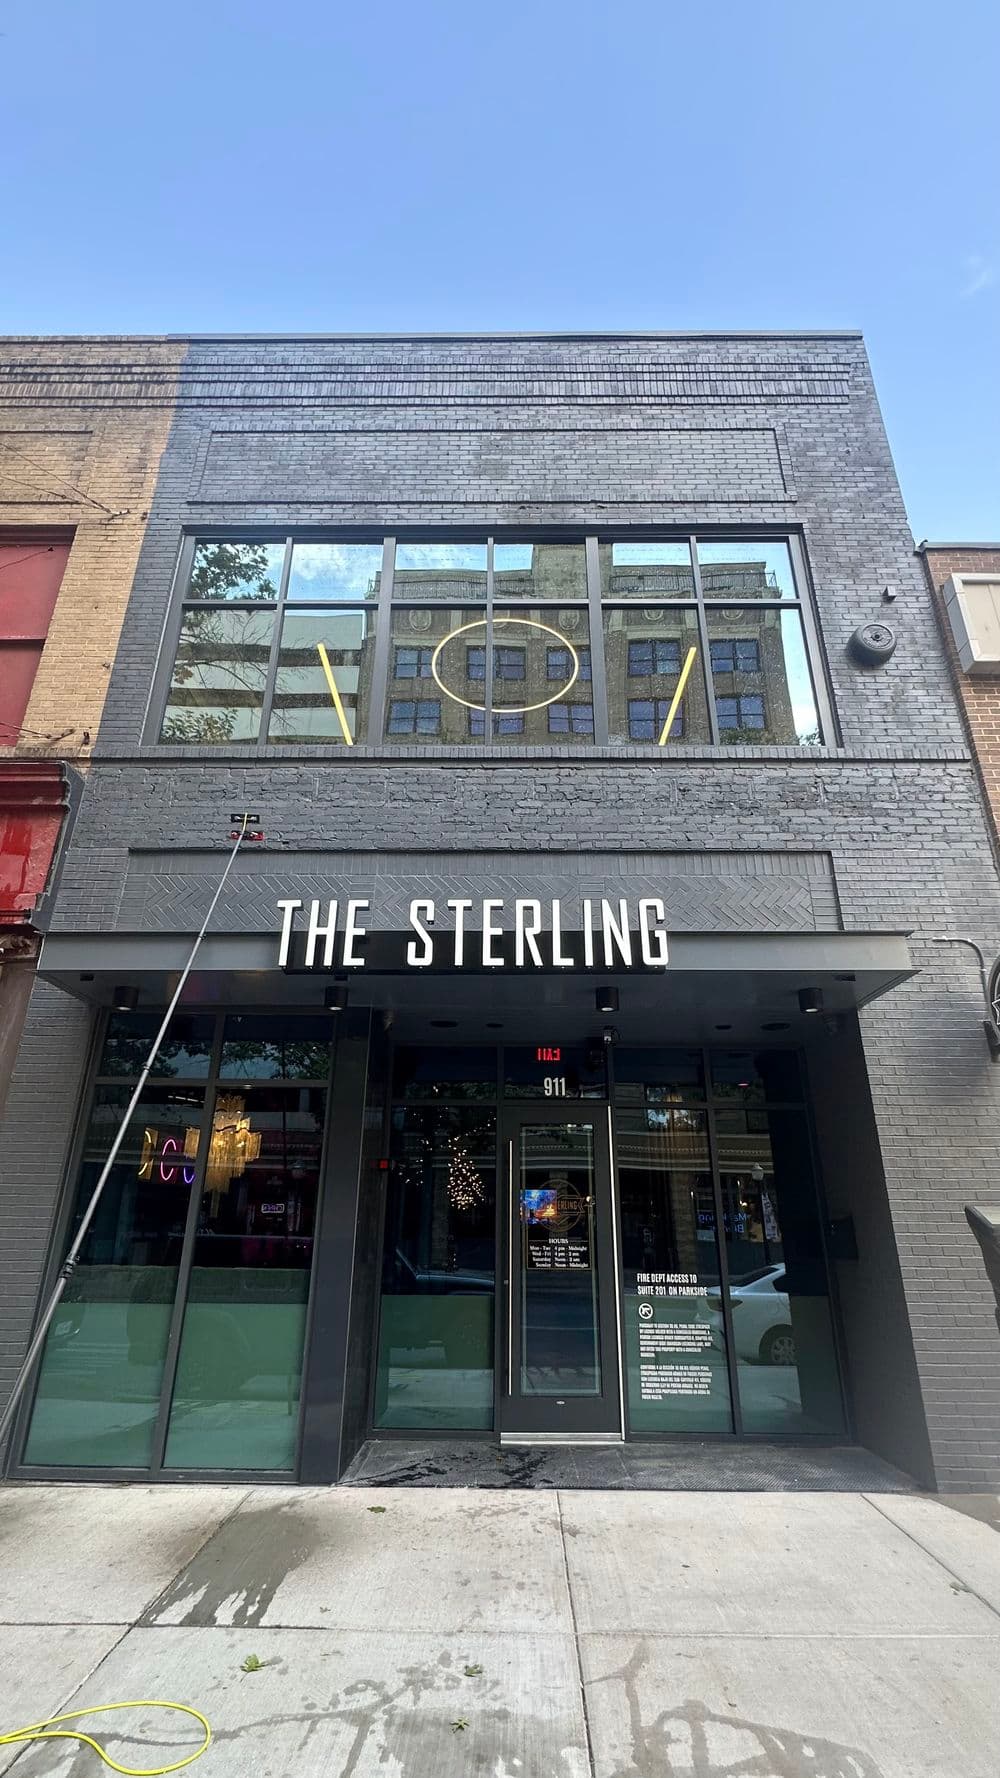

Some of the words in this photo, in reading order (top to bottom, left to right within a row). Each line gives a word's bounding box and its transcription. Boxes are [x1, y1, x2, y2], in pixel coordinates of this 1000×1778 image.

[277, 899, 371, 967] THE
[406, 898, 669, 967] STERLING
[544, 1077, 566, 1097] 911
[636, 1272, 650, 1283] FIRE
[651, 1273, 666, 1283] DEPT
[666, 1273, 689, 1284] ACCESS
[689, 1274, 697, 1284] TO
[637, 1285, 654, 1296] SUITE
[655, 1285, 666, 1296] 201
[668, 1286, 678, 1296] ON
[678, 1286, 708, 1297] PARKSIDE
